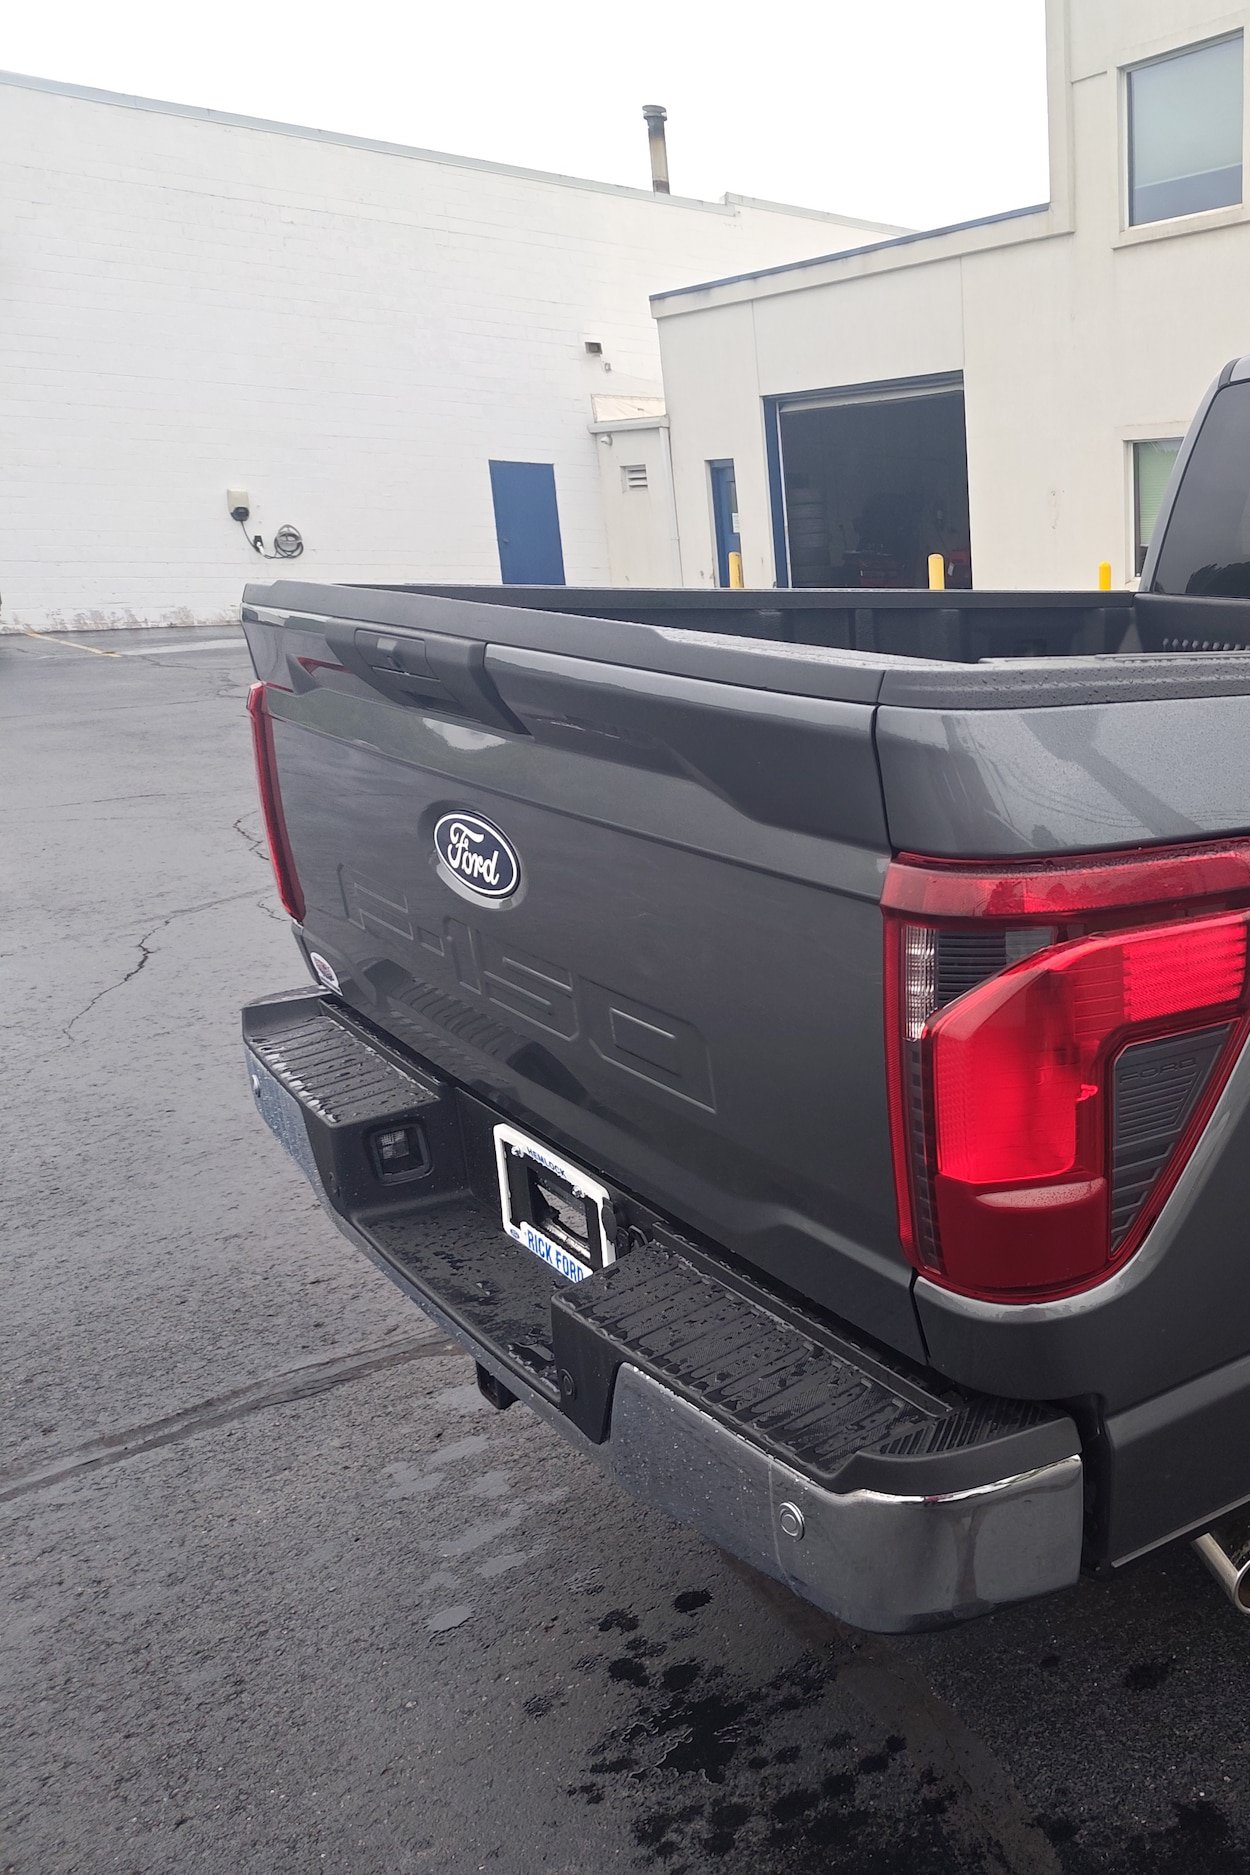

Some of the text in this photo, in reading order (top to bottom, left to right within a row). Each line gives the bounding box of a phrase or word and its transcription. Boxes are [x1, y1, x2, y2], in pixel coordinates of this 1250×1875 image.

[447, 822, 500, 886] Ford
[336, 862, 719, 1115] F-150
[1118, 1057, 1197, 1084] FORD
[526, 1146, 567, 1178] HEMLOCK
[527, 1229, 585, 1282] RICK FORD
